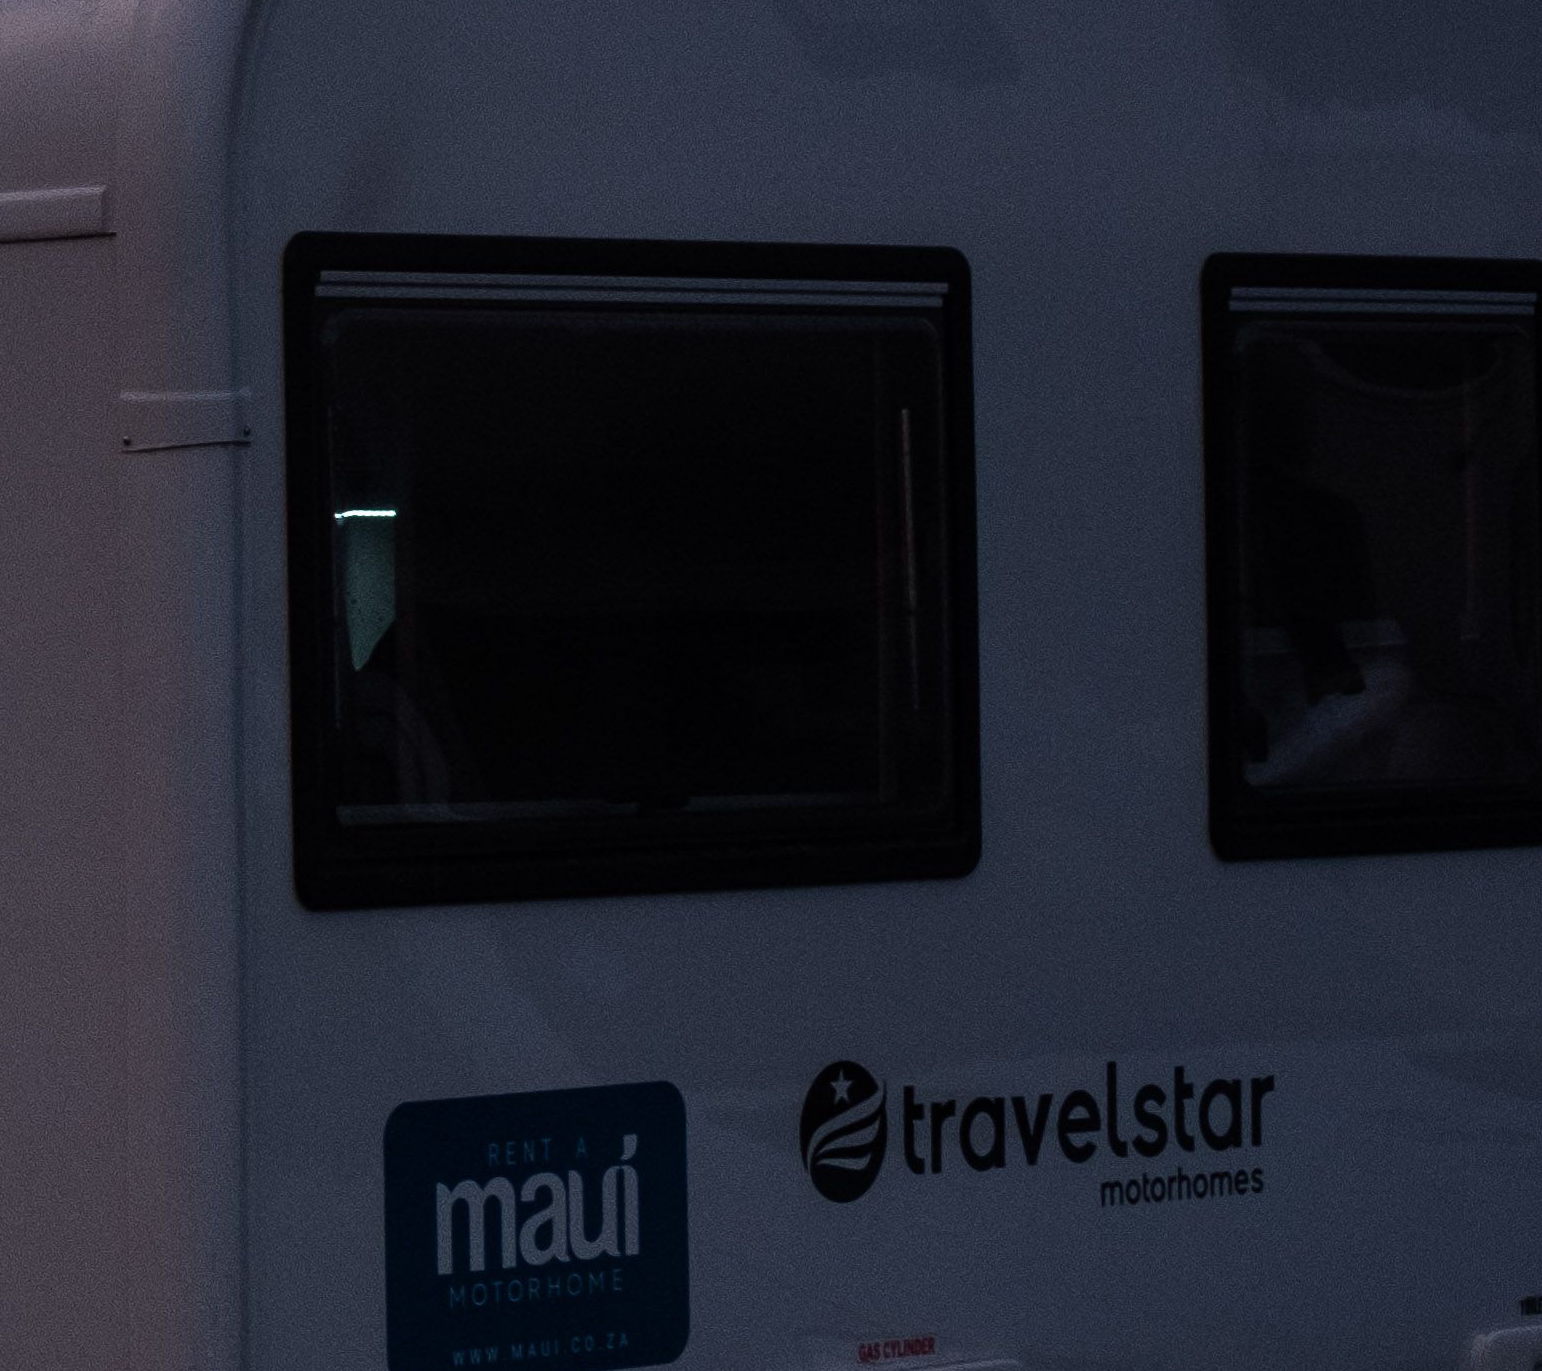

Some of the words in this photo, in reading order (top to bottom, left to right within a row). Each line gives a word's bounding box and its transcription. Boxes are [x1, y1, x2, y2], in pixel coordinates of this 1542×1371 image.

[903, 1060, 1275, 1175] travelstar
[487, 1137, 553, 1167] RENT
[575, 1136, 590, 1160] A
[1100, 1166, 1265, 1208] motorhomes
[449, 1268, 624, 1309] MOTORHOME
[858, 1342, 881, 1363] GAS
[882, 1336, 936, 1359] CYLINDER
